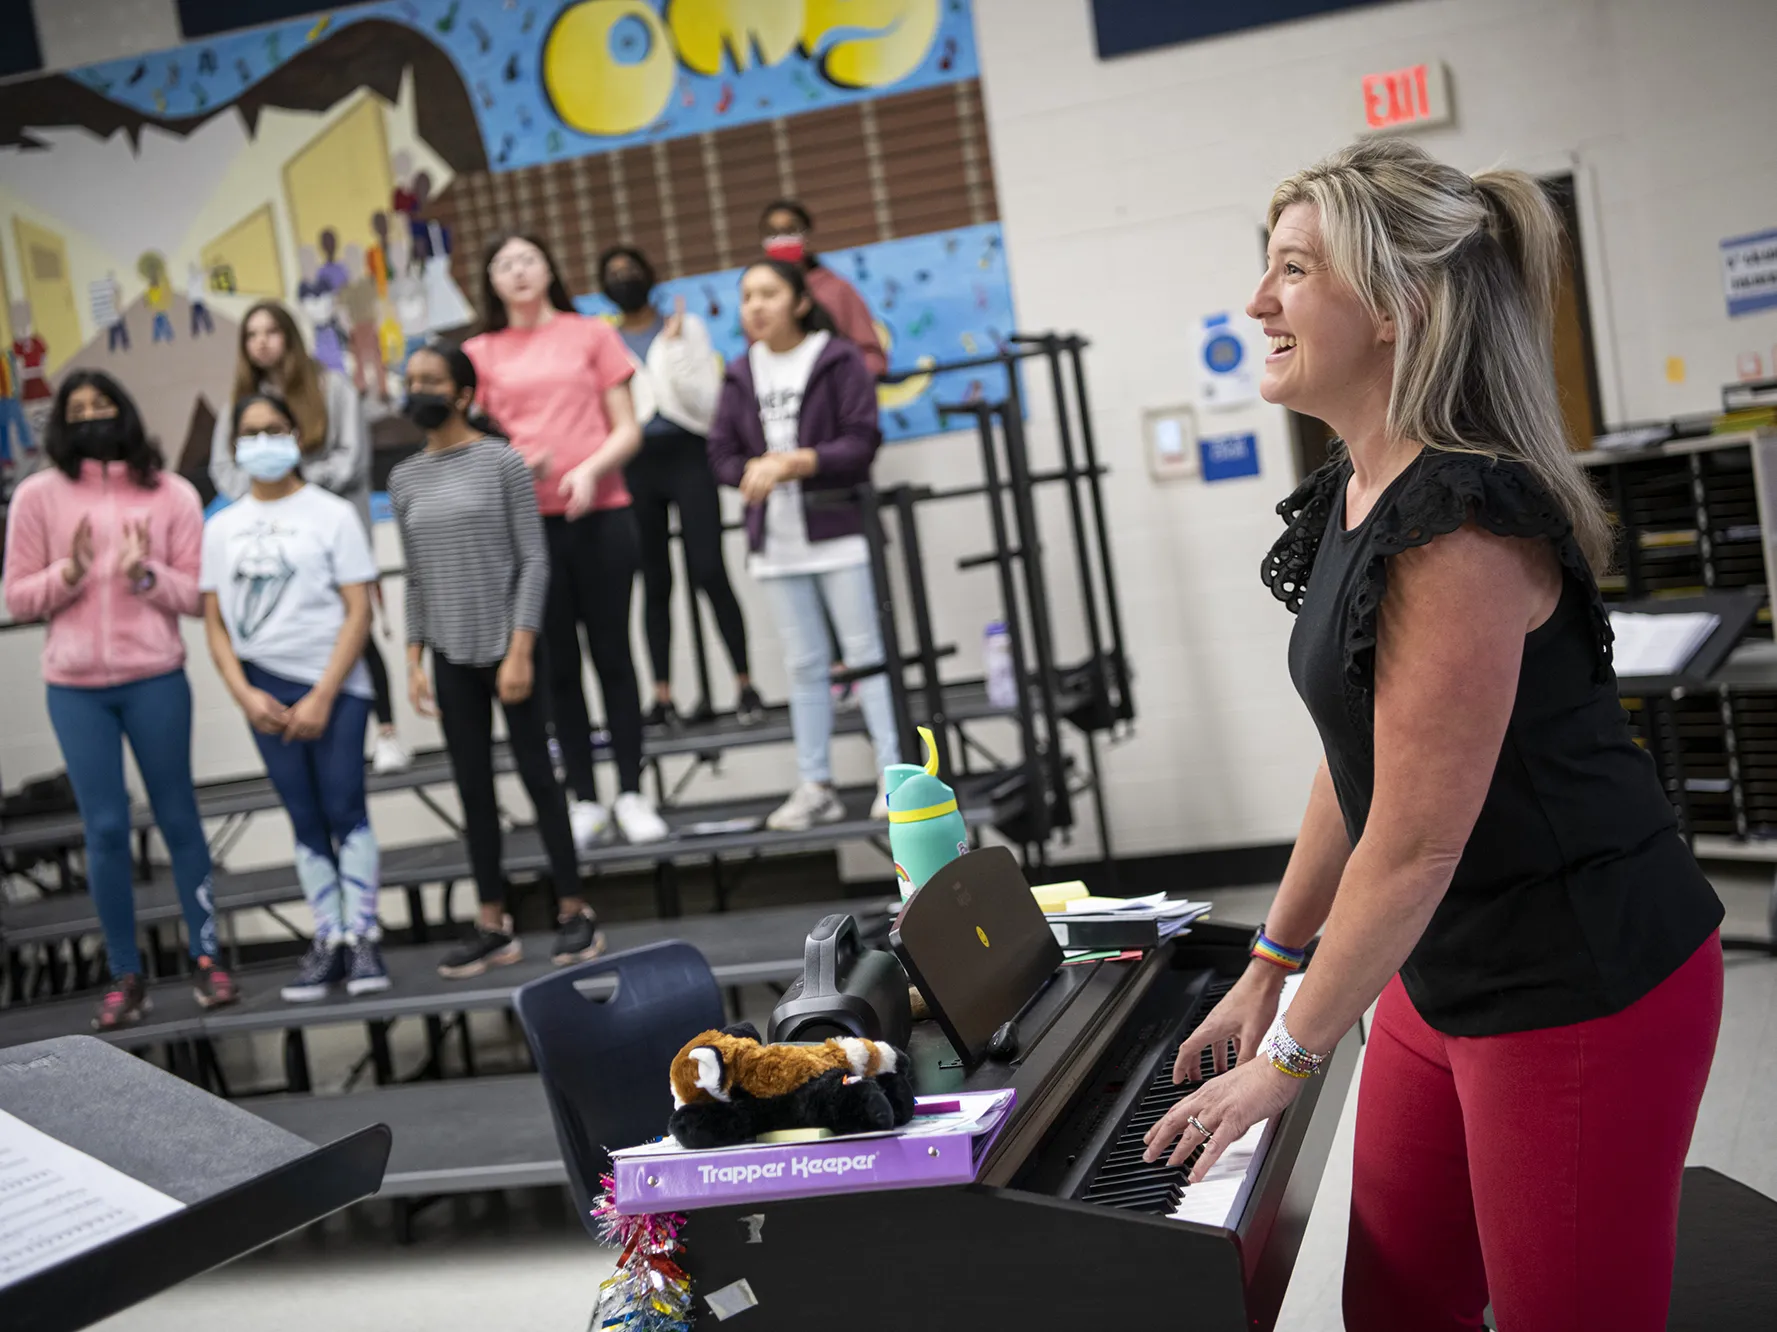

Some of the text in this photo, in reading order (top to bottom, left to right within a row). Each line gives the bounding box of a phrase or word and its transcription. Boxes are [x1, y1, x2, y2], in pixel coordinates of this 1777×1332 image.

[1362, 64, 1430, 129] EXIT
[698, 1154, 876, 1184] Trapper Keeper
